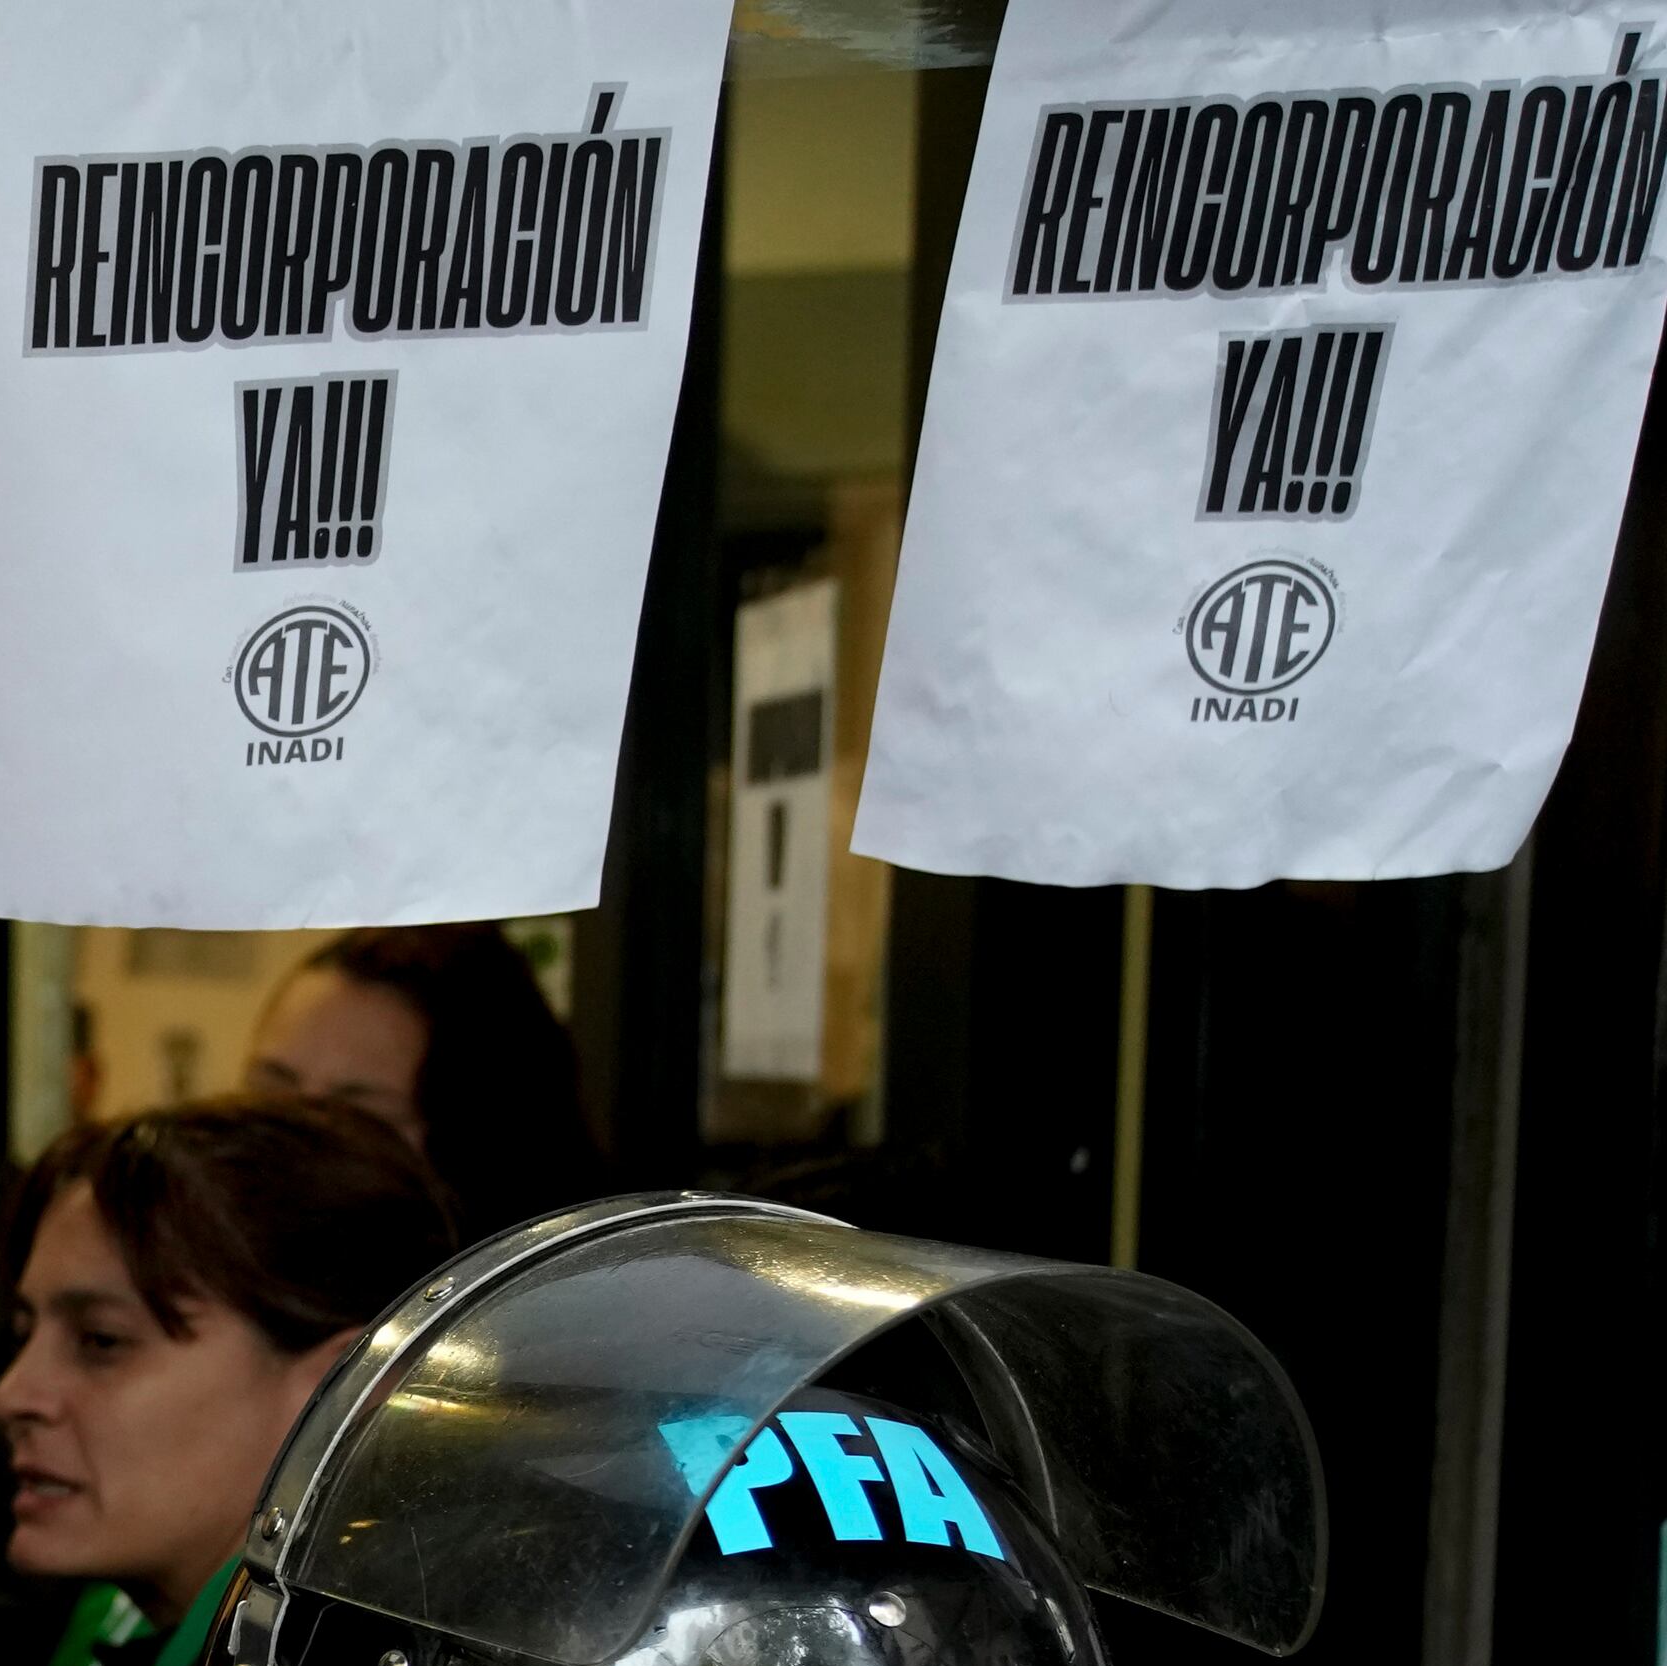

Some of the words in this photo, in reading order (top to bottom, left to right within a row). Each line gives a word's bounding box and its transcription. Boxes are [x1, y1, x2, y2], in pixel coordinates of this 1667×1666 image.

[31, 92, 662, 349] REINCORPORACIÓN
[1012, 32, 1667, 295] REINCORPORACIÓN
[242, 378, 389, 564] YA!!!
[1205, 330, 1385, 514] YA!!!
[248, 619, 355, 727] ATE
[1199, 573, 1319, 685] ATE
[246, 737, 345, 767] INADI
[1190, 697, 1299, 722] INADI
[656, 1408, 1006, 1561] PFA
